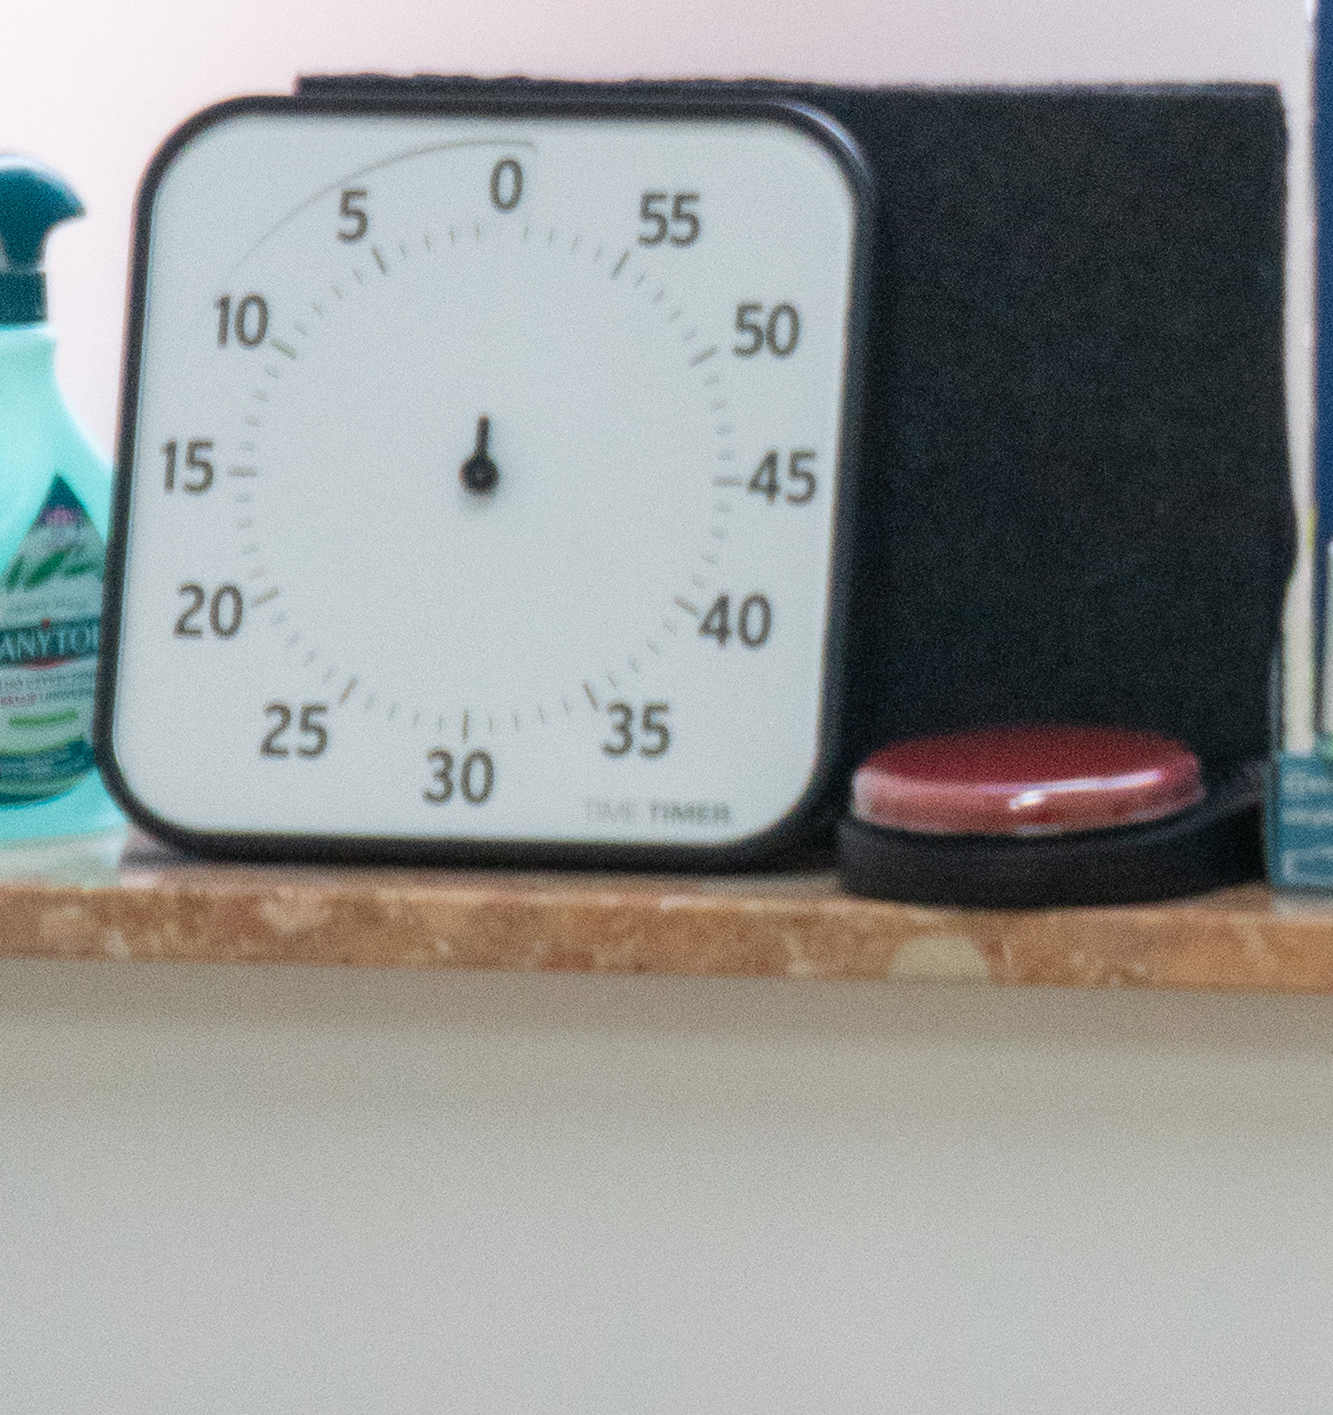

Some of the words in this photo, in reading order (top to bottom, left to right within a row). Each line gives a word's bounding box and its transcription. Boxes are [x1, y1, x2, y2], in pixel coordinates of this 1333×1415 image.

[489, 158, 525, 212] 0
[337, 189, 369, 242] 5
[638, 193, 701, 246] 55
[214, 295, 270, 347] 10
[733, 304, 801, 357] 50
[161, 440, 215, 493] 15
[747, 451, 817, 503] 45
[174, 584, 244, 638] 20
[699, 595, 772, 647] 40
[260, 703, 329, 758] 25
[603, 703, 671, 758] 35
[423, 750, 495, 804] 30
